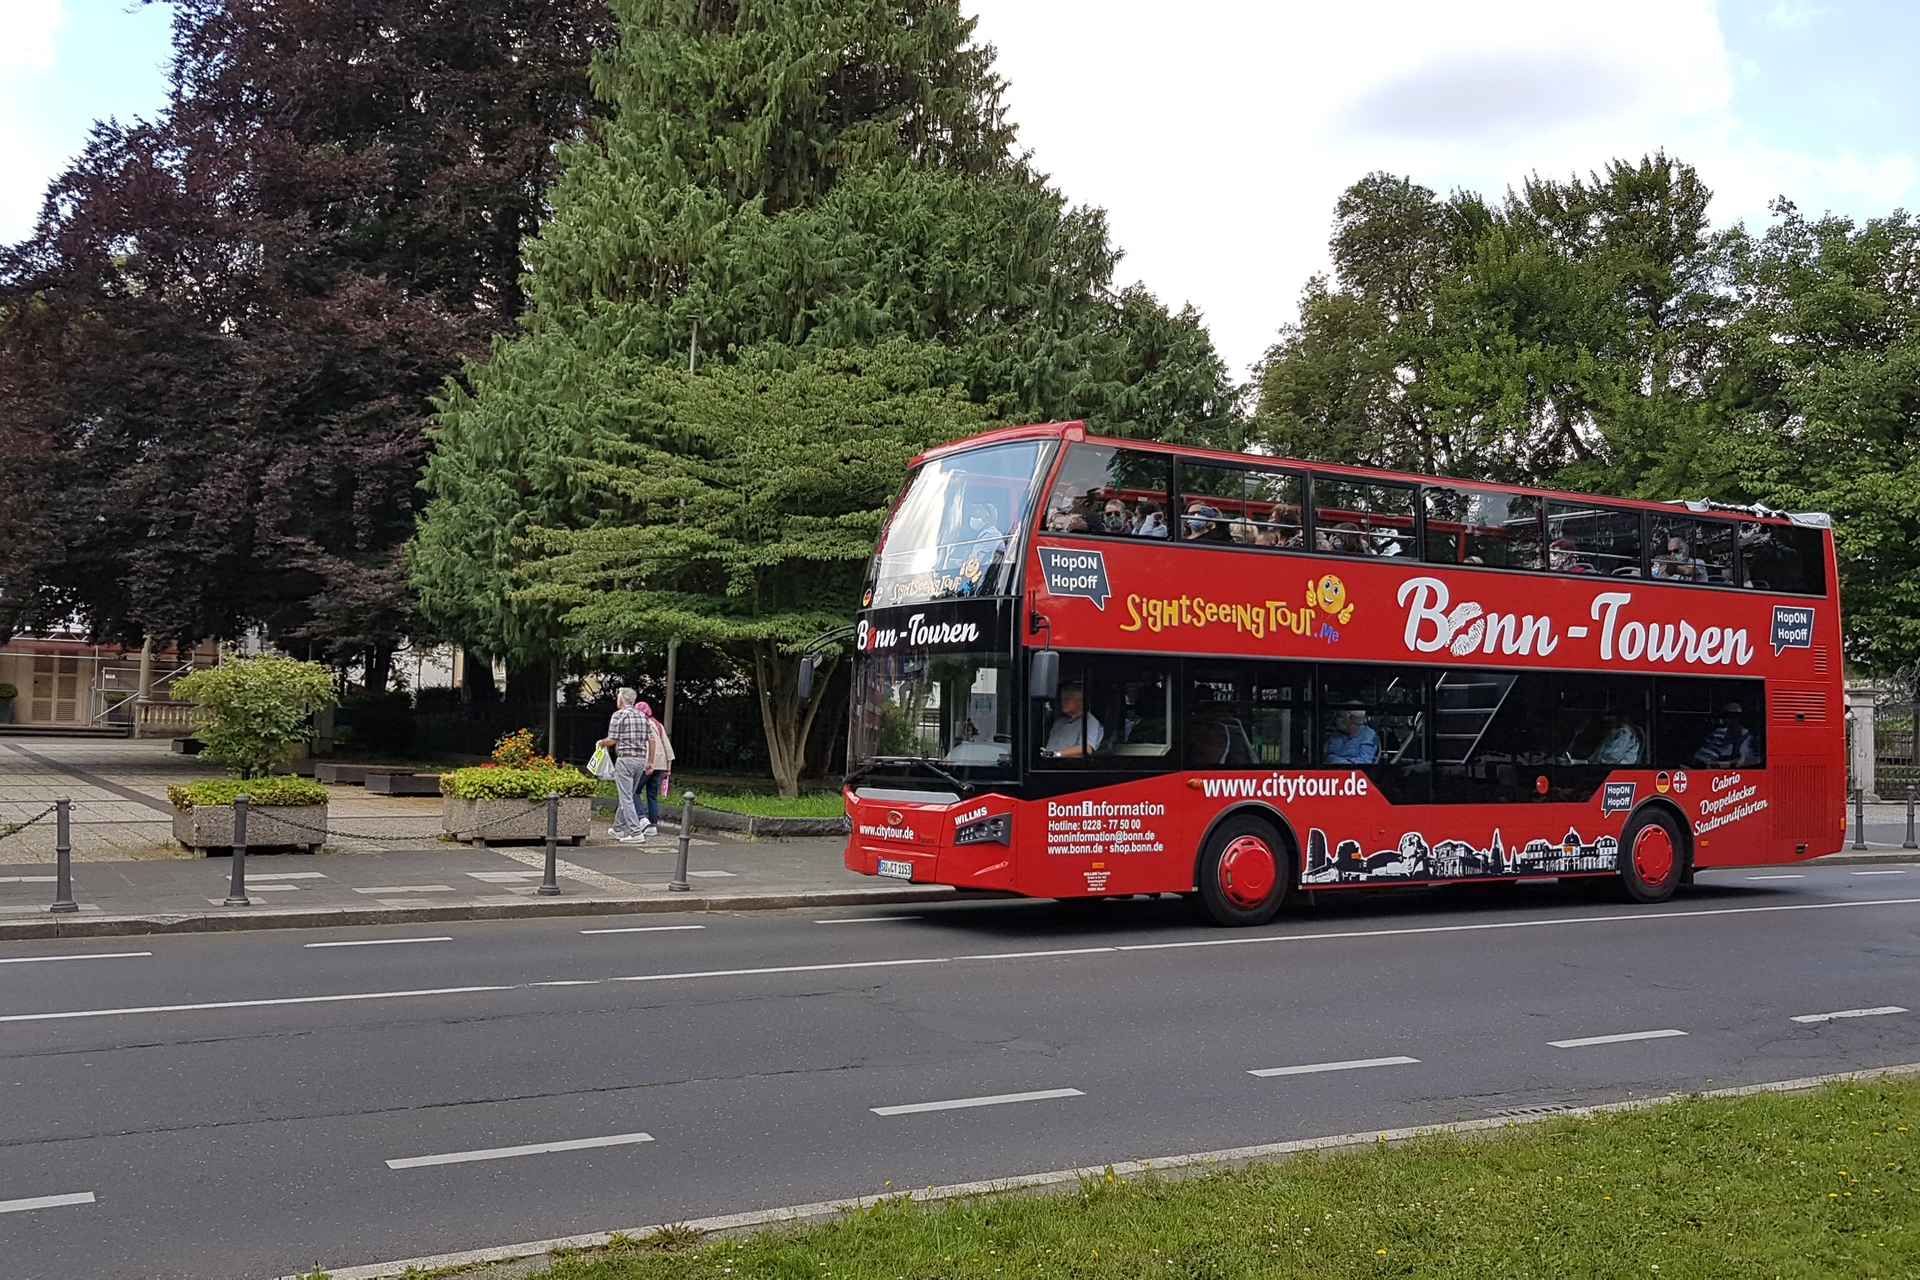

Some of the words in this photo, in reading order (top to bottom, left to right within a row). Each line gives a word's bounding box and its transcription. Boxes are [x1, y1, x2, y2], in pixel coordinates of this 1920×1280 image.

[1051, 554, 1098, 572] HopON
[1051, 574, 1098, 592] HopOff
[1777, 611, 1808, 626] HopON
[1778, 628, 1808, 643] HopOff
[1203, 771, 1368, 804] www.citytour.de
[1711, 771, 1741, 793] Cabrio
[1607, 786, 1631, 796] HopON
[1607, 797, 1631, 808] HopOff
[1699, 785, 1757, 816] Doppeldecker
[954, 806, 989, 827] WILLMS
[1048, 820, 1081, 831] Hotline:
[1082, 819, 1102, 831] 0228
[1108, 819, 1118, 831] 77
[1120, 819, 1130, 830] 50
[1131, 819, 1141, 830] 00
[1693, 799, 1769, 837] Stadtrundfahrten
[859, 824, 915, 841] www.citytour.de
[1048, 830, 1156, 844] bonninformation@bonn.de
[1047, 842, 1104, 855] www.bonn.de
[1109, 841, 1165, 855] shop.bonn.de
